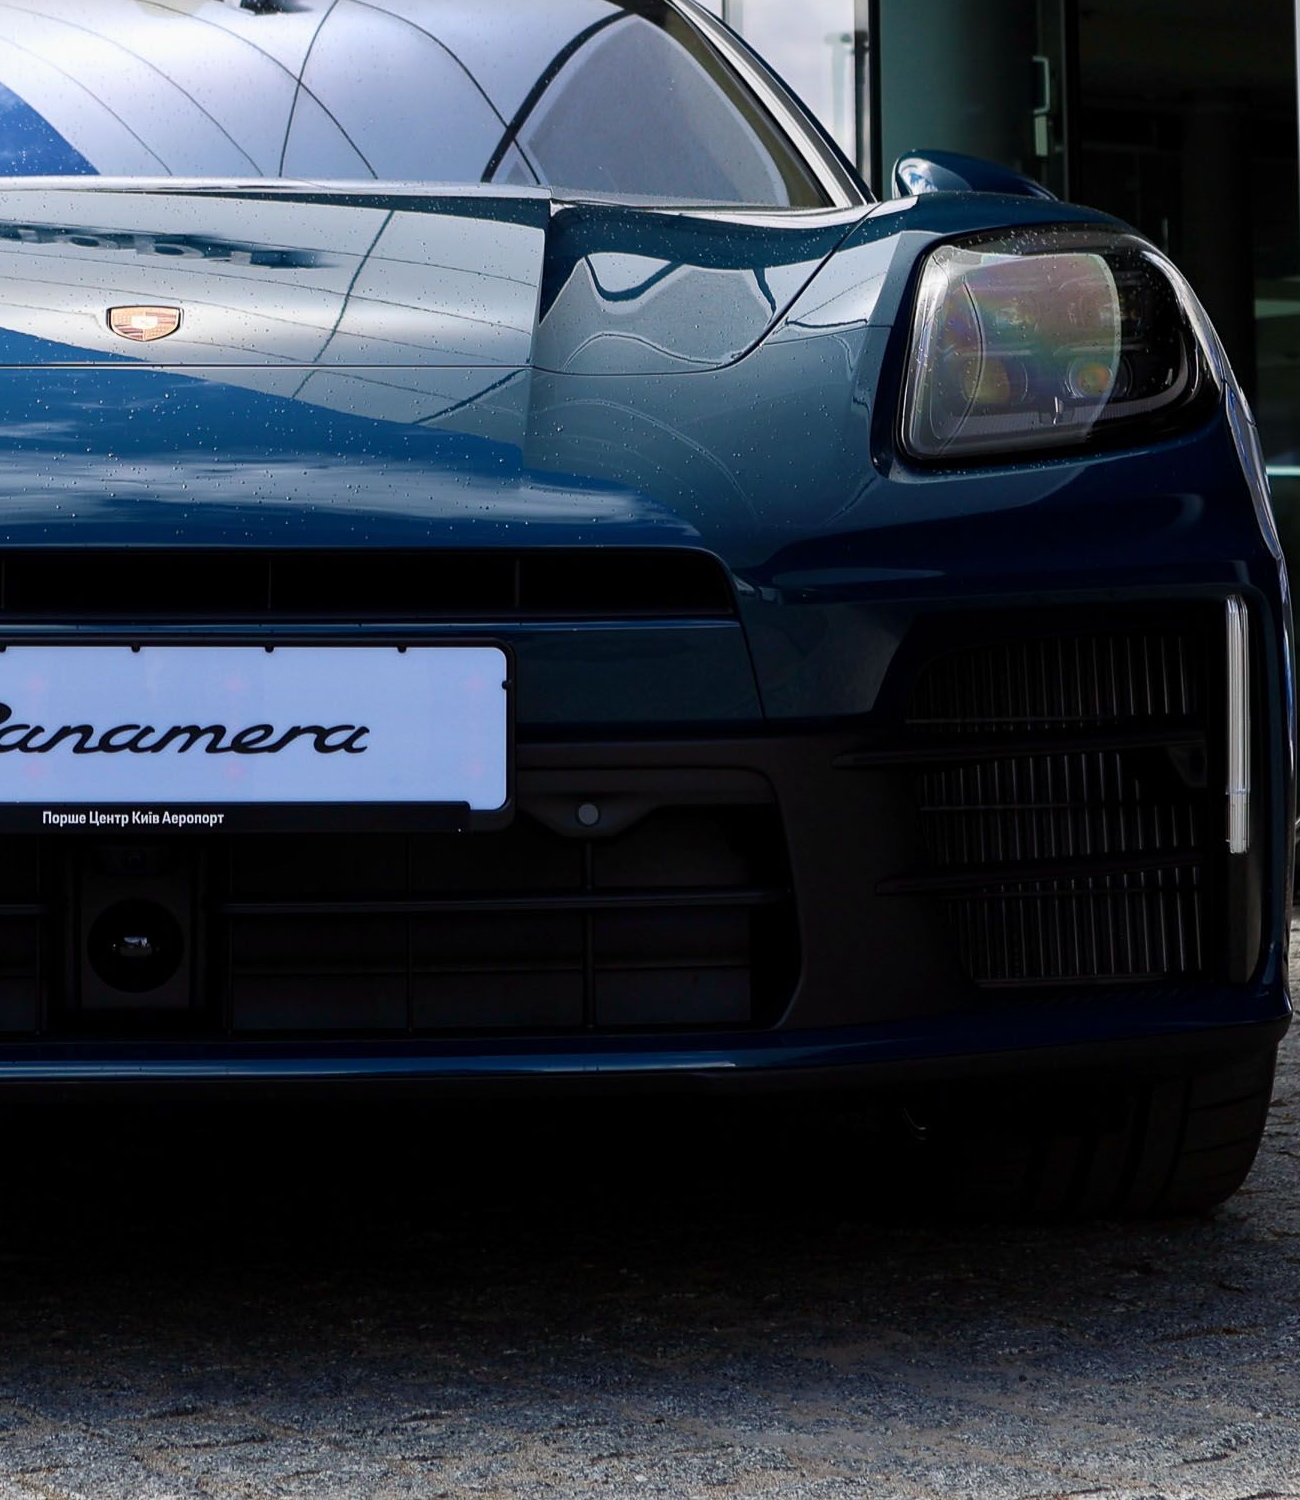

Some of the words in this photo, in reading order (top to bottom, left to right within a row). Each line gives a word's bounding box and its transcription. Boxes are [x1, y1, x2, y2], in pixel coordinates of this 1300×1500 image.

[42, 810, 86, 828] Порше
[89, 810, 129, 828] Центр
[131, 810, 160, 825] Київ
[161, 810, 225, 828] Аеропорт
